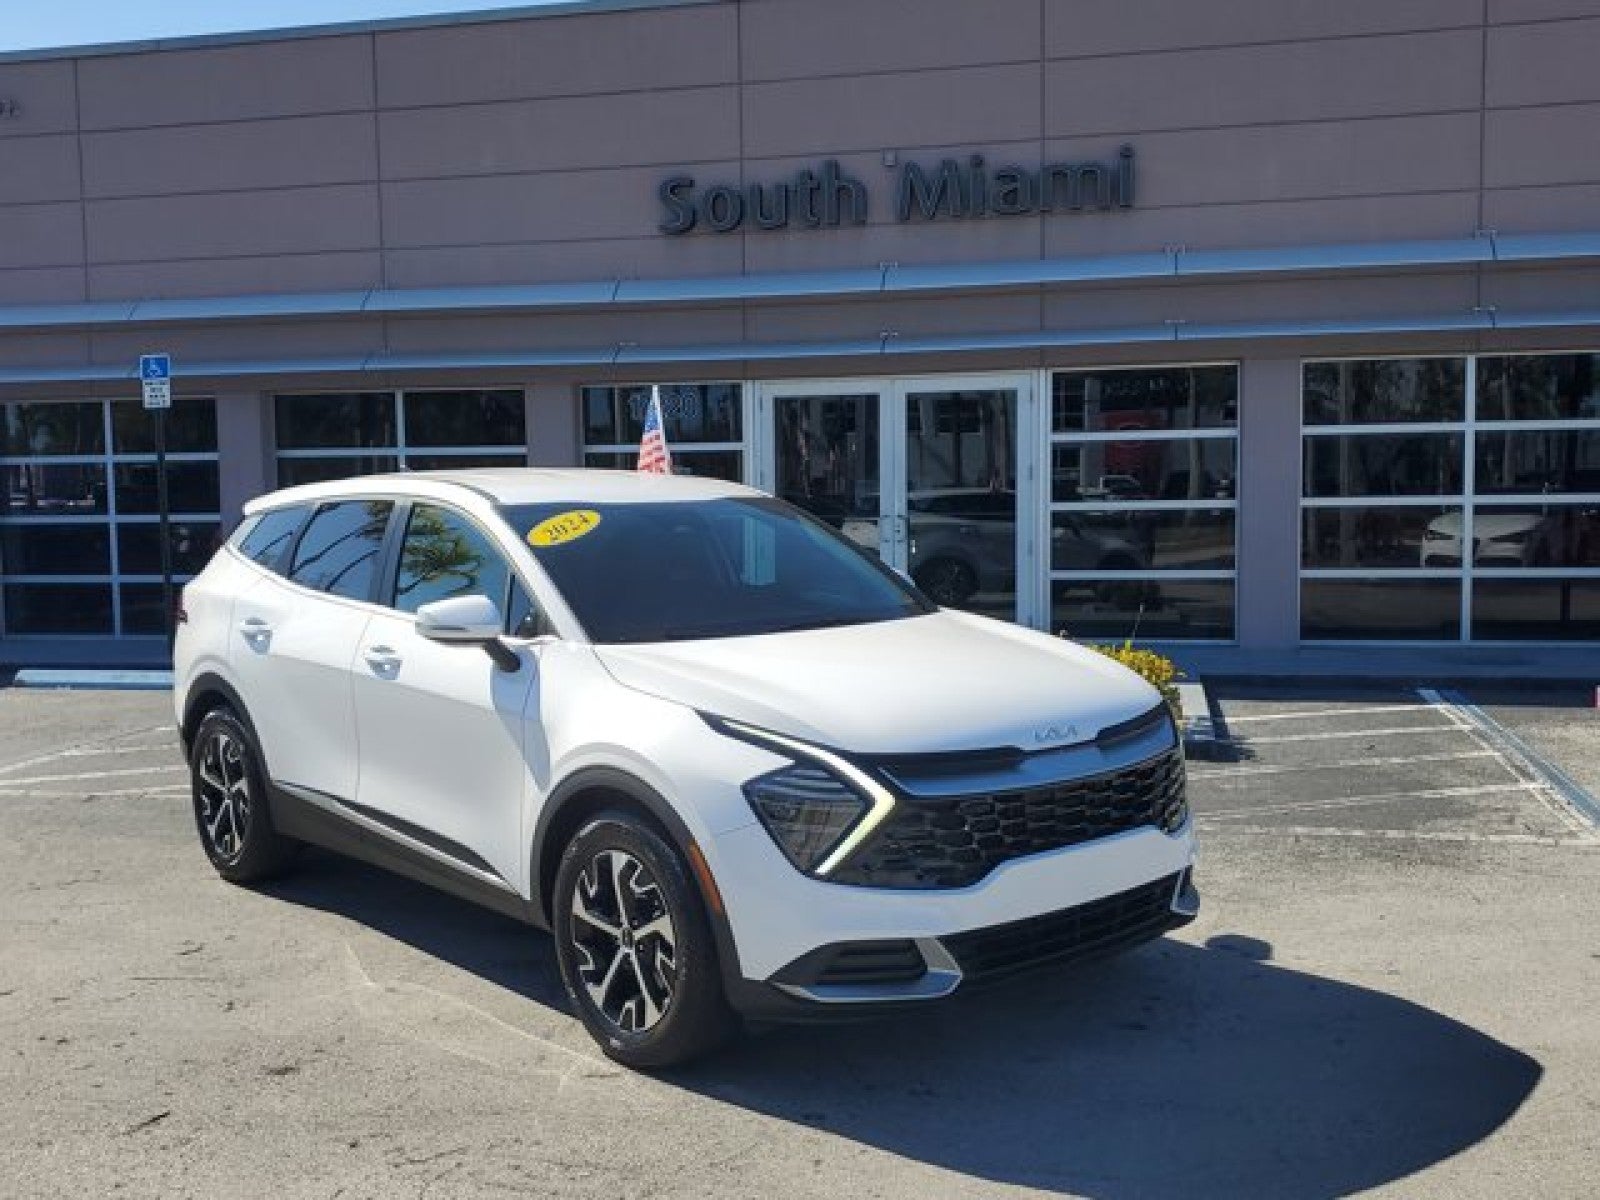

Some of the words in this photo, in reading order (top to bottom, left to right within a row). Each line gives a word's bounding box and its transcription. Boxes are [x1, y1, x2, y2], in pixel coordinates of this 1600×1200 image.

[659, 160, 867, 235] South
[902, 144, 1134, 221] Miami
[545, 512, 590, 541] 2024
